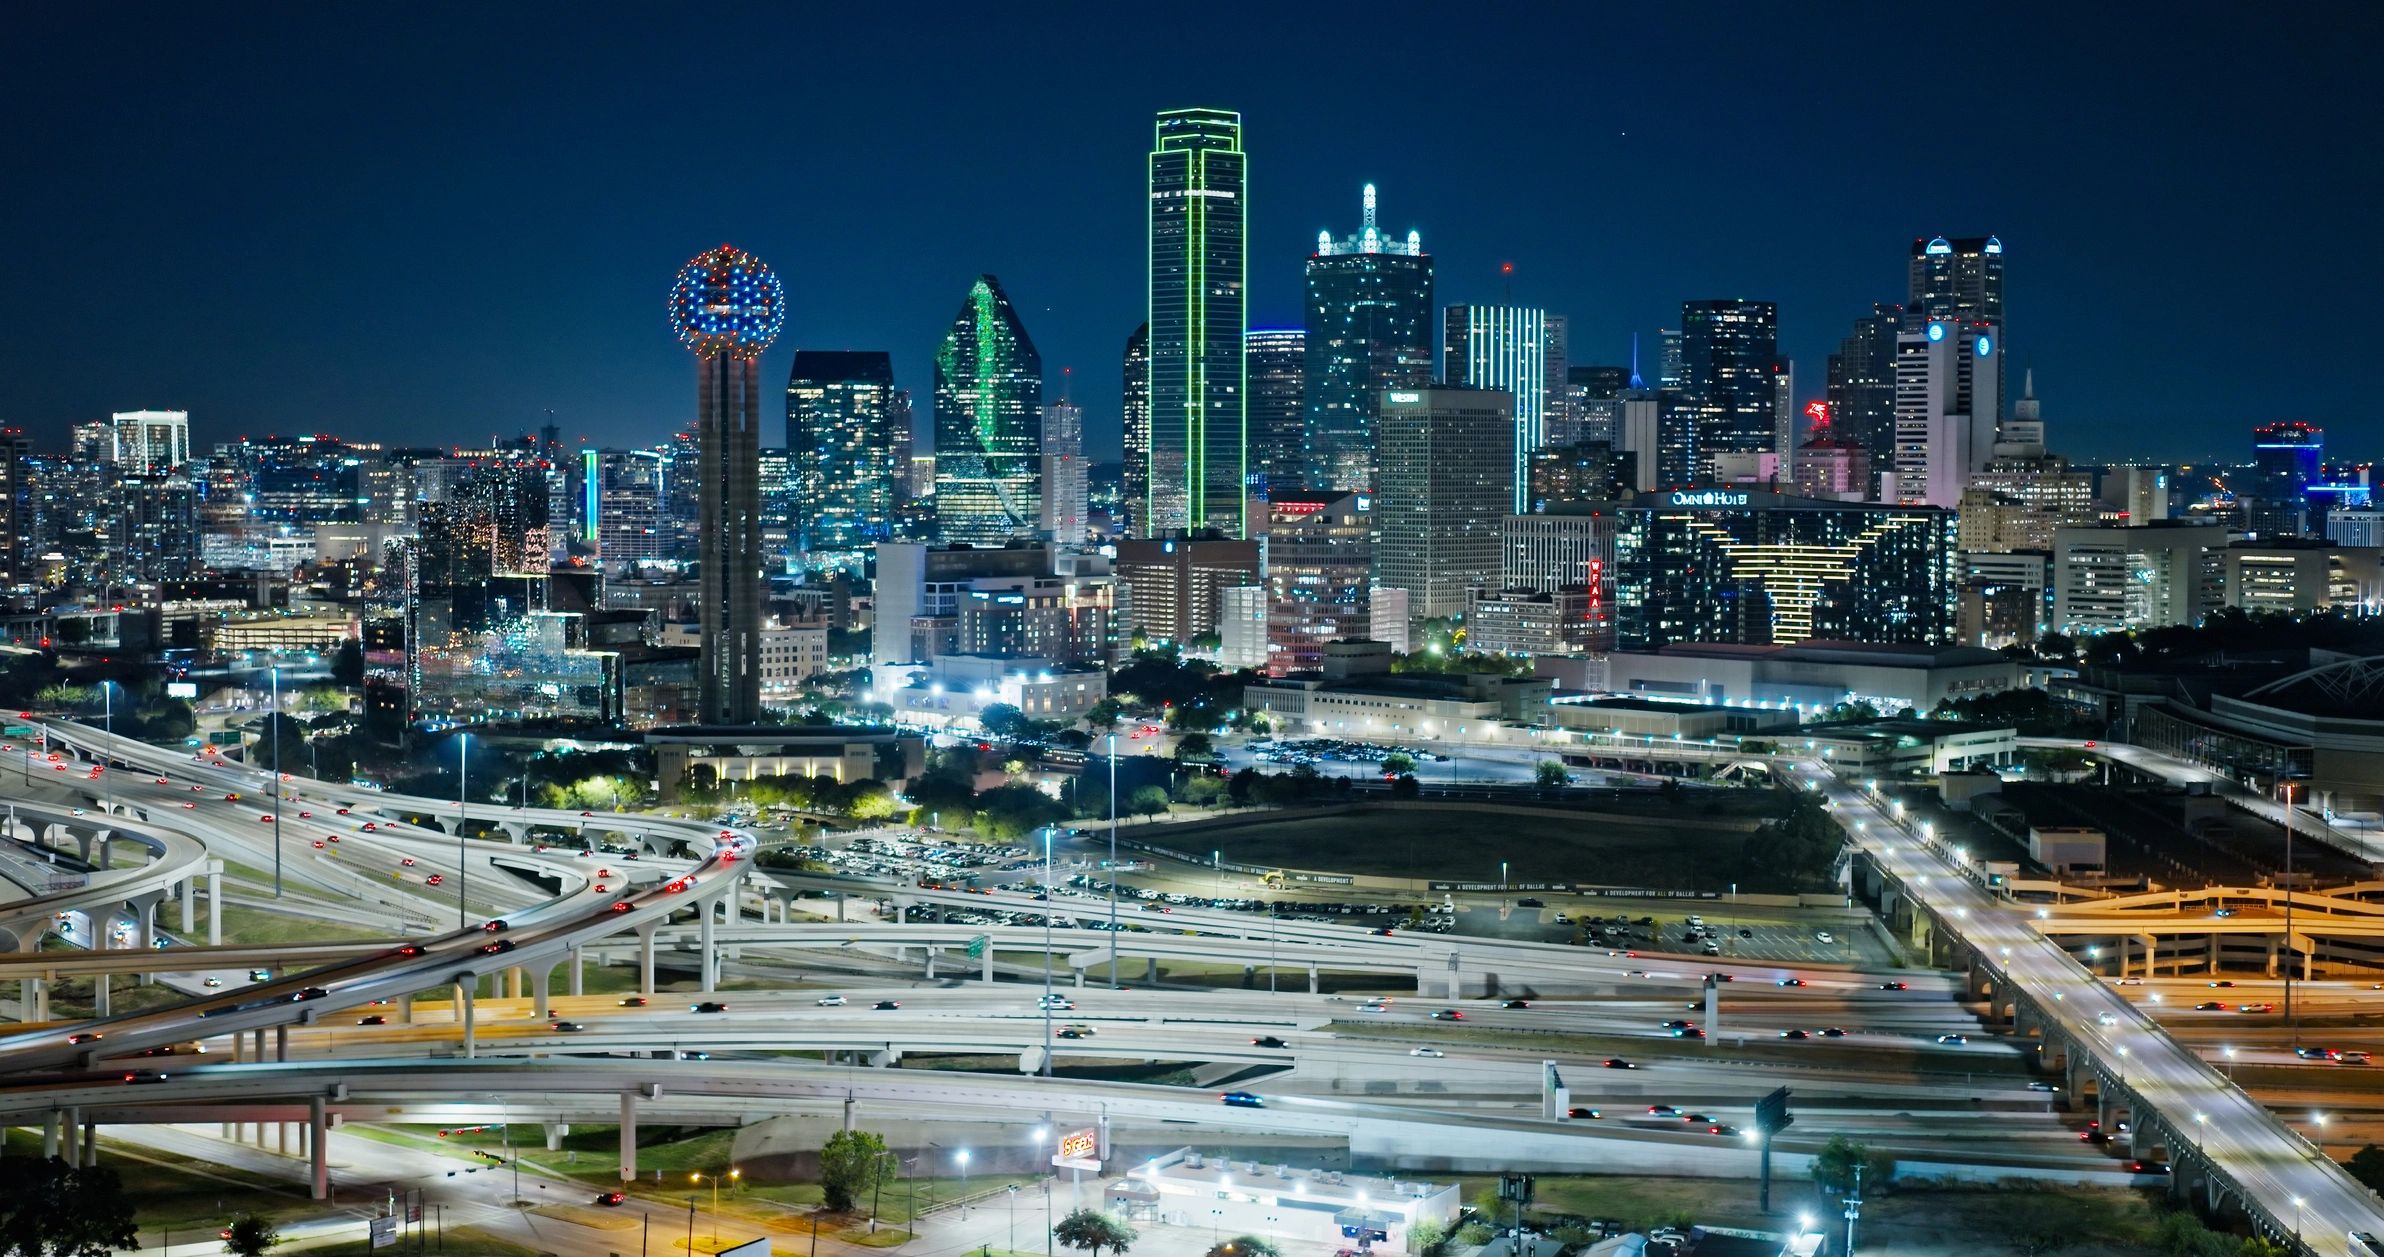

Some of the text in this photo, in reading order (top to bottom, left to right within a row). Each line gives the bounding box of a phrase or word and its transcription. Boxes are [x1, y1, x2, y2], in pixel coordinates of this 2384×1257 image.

[1672, 491, 1703, 505] OMNI
[1591, 561, 1600, 607] WFAA
[1318, 875, 1349, 884] DEVELOPMENT
